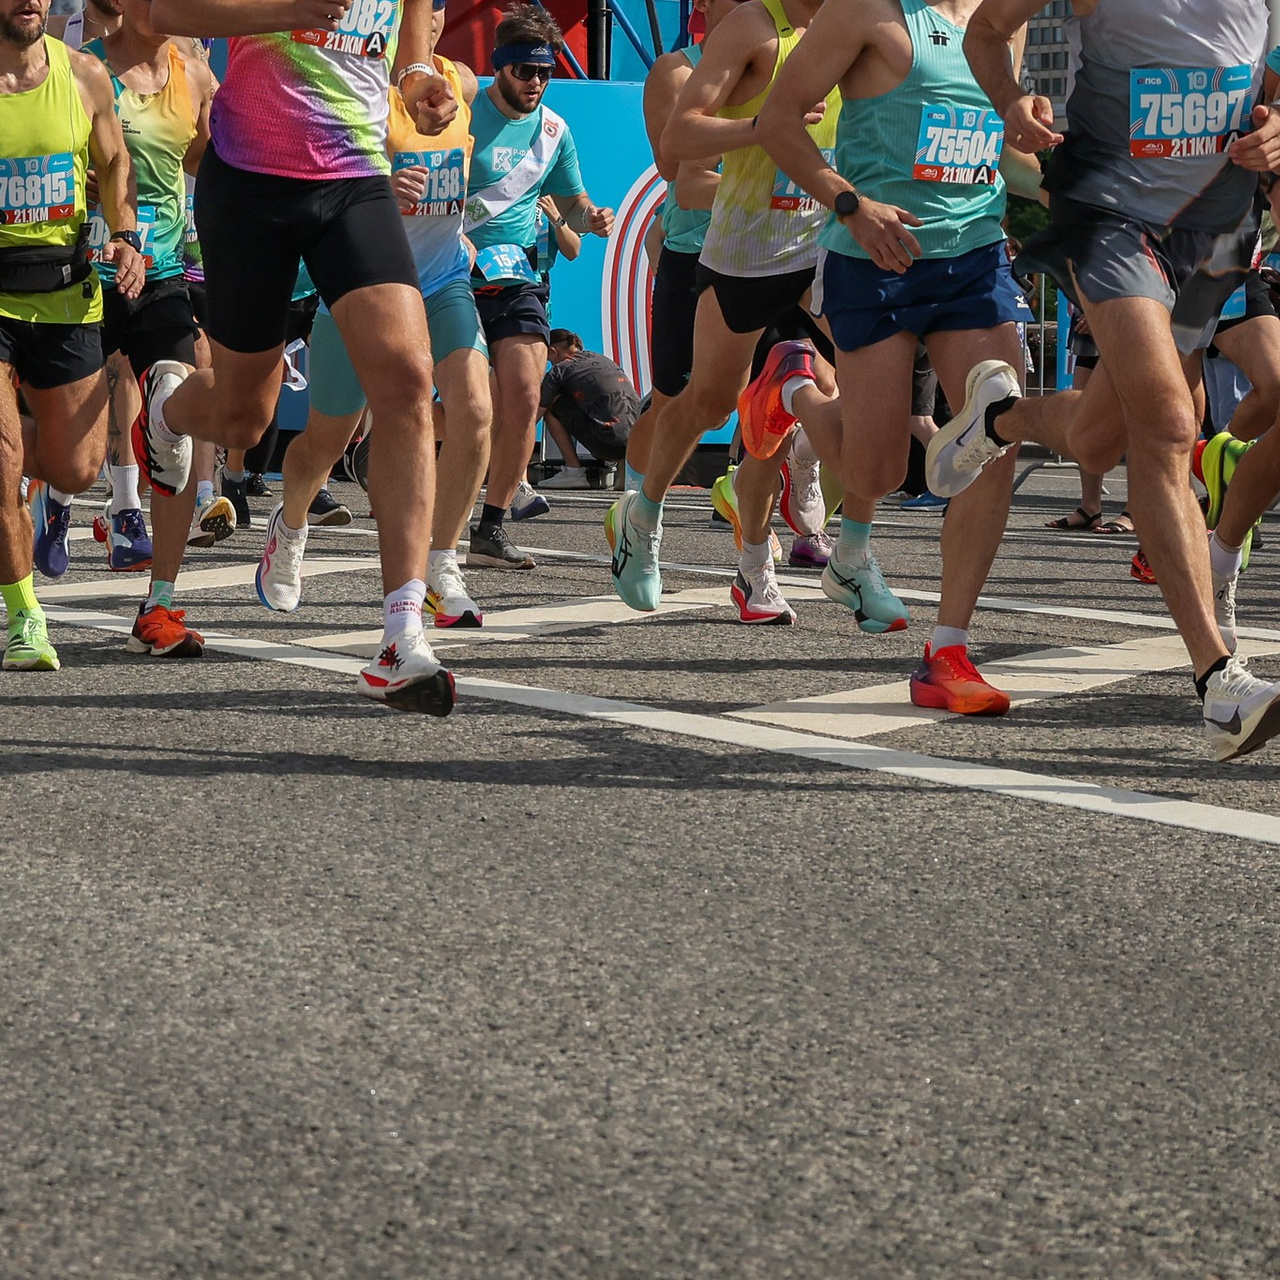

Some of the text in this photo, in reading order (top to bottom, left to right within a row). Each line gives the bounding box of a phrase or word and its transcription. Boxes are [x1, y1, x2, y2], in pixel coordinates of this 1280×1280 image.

[323, 31, 382, 55] 21.1KM A
[1145, 77, 1162, 85] ПСБ
[1140, 88, 1246, 136] 75697
[925, 126, 998, 167] 75504
[1171, 135, 1217, 157] 21.1KM
[420, 166, 460, 200] 138
[941, 166, 989, 184] 21.1KM A
[13, 207, 49, 224] 21.1KM
[415, 200, 460, 216] 21.1KM A
